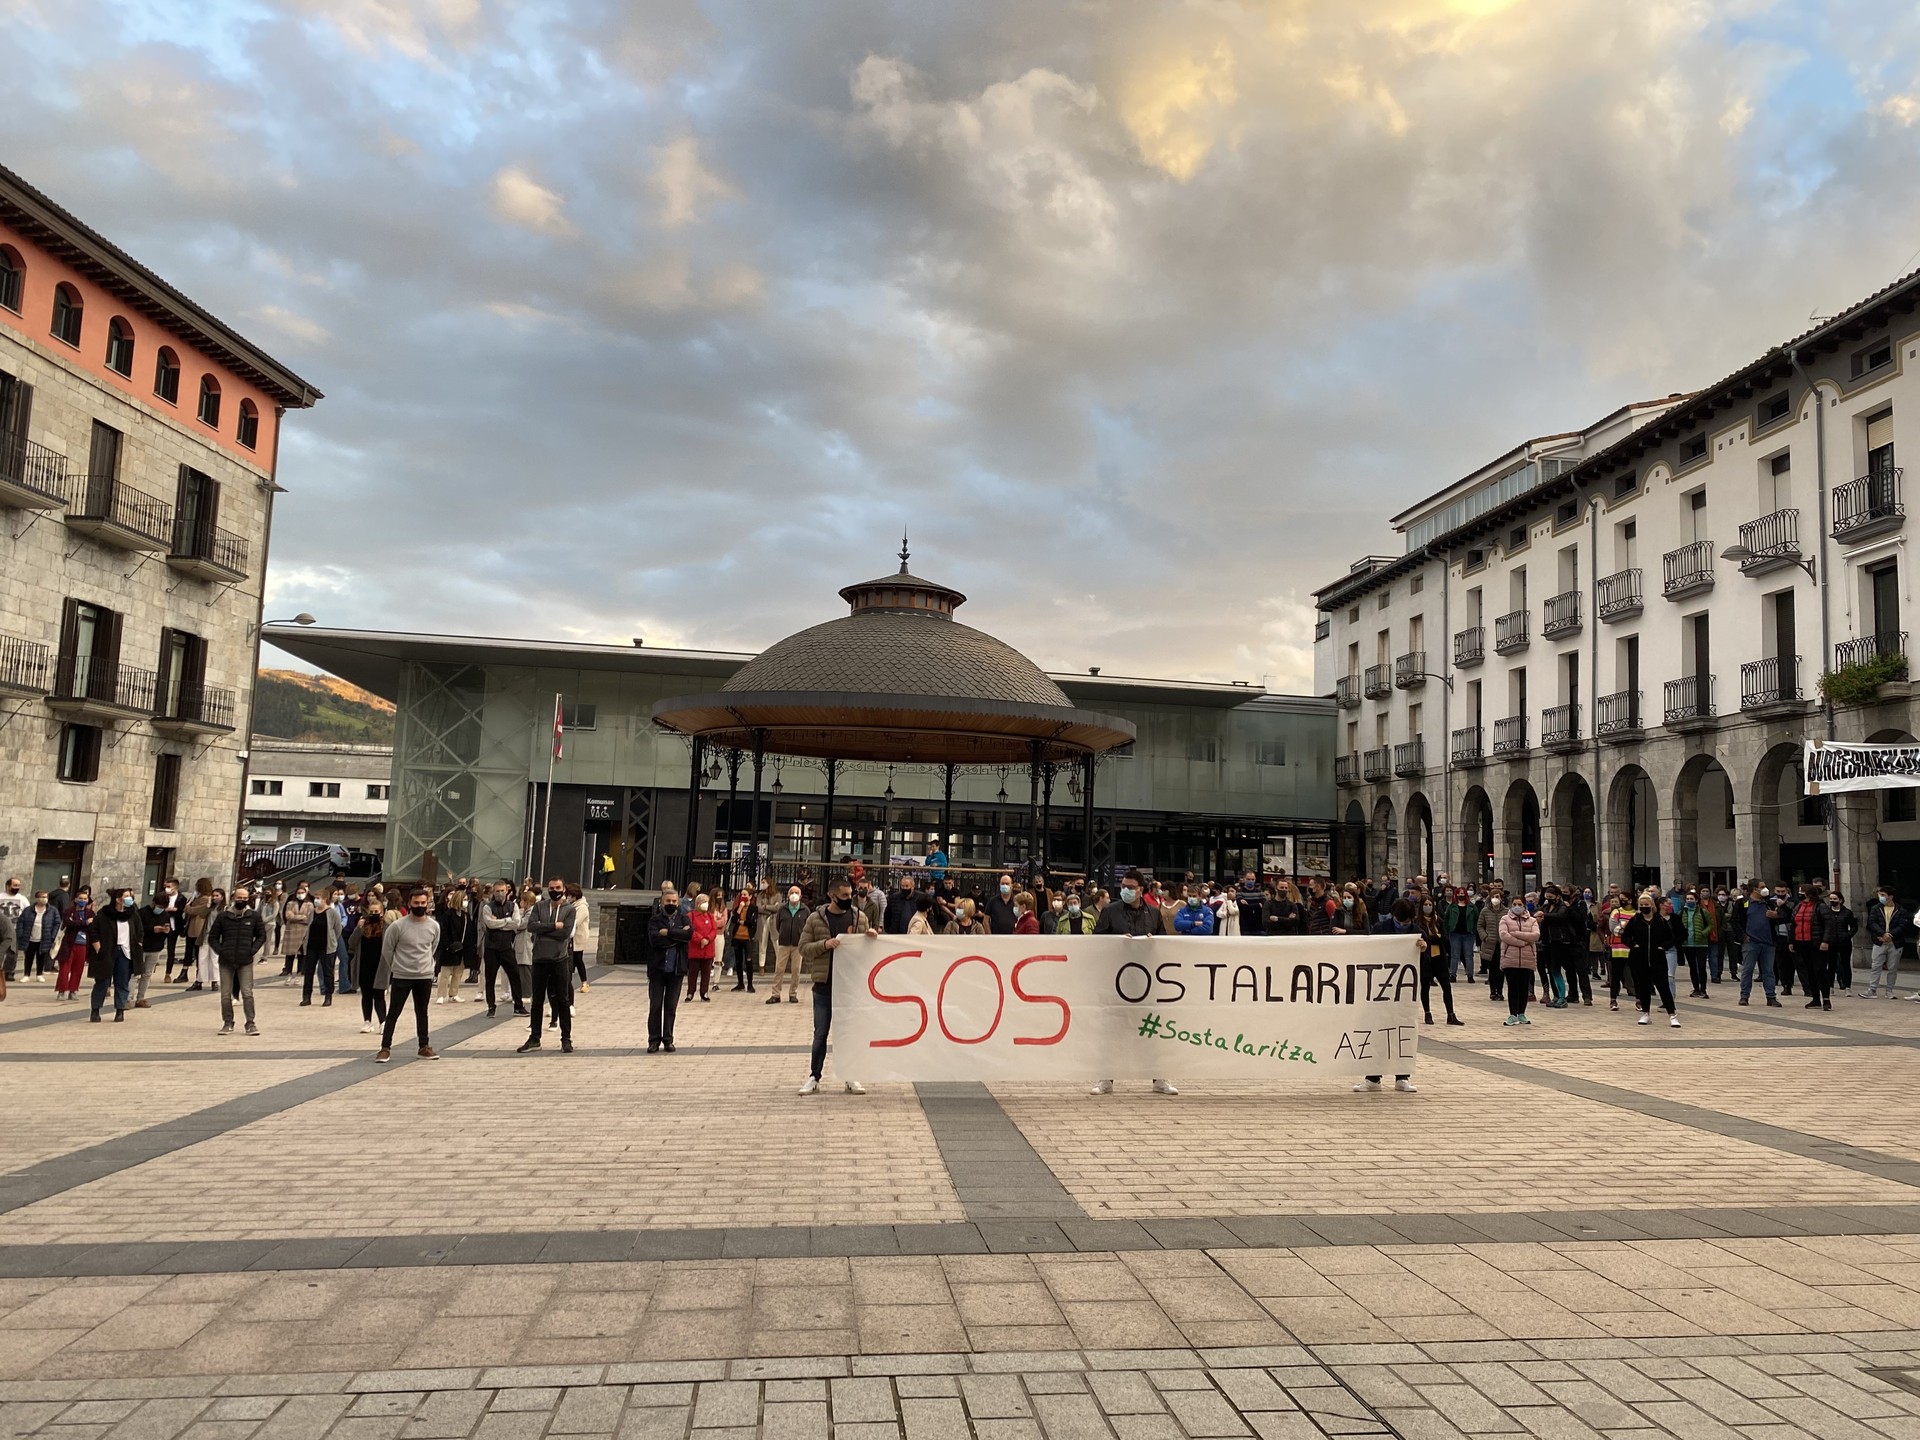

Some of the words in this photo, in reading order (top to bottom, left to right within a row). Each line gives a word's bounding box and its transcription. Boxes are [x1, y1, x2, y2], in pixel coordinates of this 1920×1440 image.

[867, 950, 1071, 1048] SOS
[1115, 961, 1419, 1005] OSTALARITZA
[1138, 1012, 1318, 1064] #Sostalaritza
